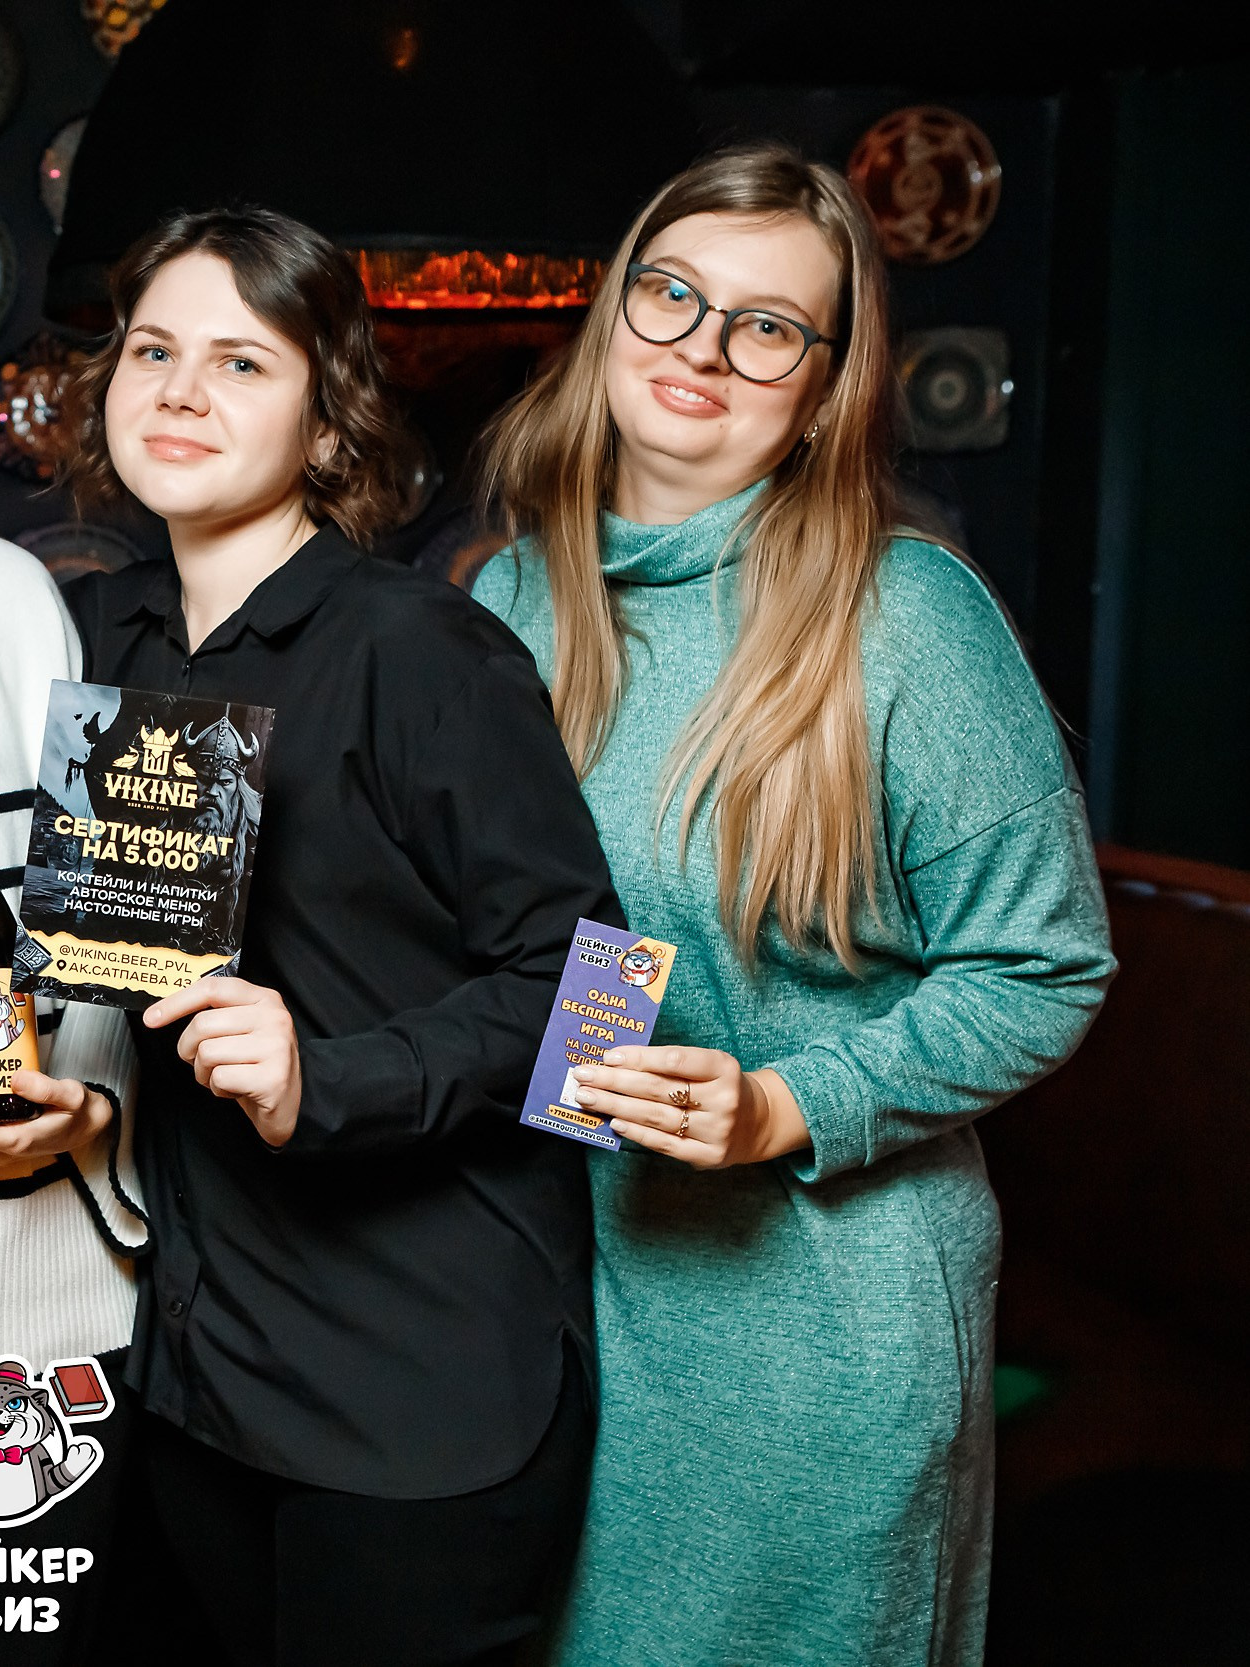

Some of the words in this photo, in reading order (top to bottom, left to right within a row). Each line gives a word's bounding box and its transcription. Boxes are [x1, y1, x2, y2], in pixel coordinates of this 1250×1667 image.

[104, 772, 199, 809] VIKING
[54, 815, 234, 857] СЕРТИФИКАТ
[82, 837, 119, 863] НА
[123, 845, 199, 872] 5.000
[57, 870, 133, 891] КОКТЕЙЛИ
[136, 880, 147, 892] И
[150, 883, 218, 902] НАПИТКИ
[69, 886, 155, 908] АВТОРСКОЕ
[157, 898, 201, 913] МЕНЮ
[63, 899, 161, 922] НАСТОЛЬНЫЕ
[163, 912, 204, 928] ИГРЫ
[59, 945, 192, 973] @VIKING.BEER_PVL
[576, 935, 622, 957] ШЕЙКЕР
[579, 952, 611, 968] КВИЗ
[68, 962, 169, 986] АК.САТПАЕВА
[587, 988, 627, 1010] ОДНА
[561, 999, 645, 1033] БЕСПЛАТНАЯ
[580, 1022, 615, 1042] ИГРА
[565, 1037, 580, 1049] НА
[583, 1042, 609, 1056] ОДН
